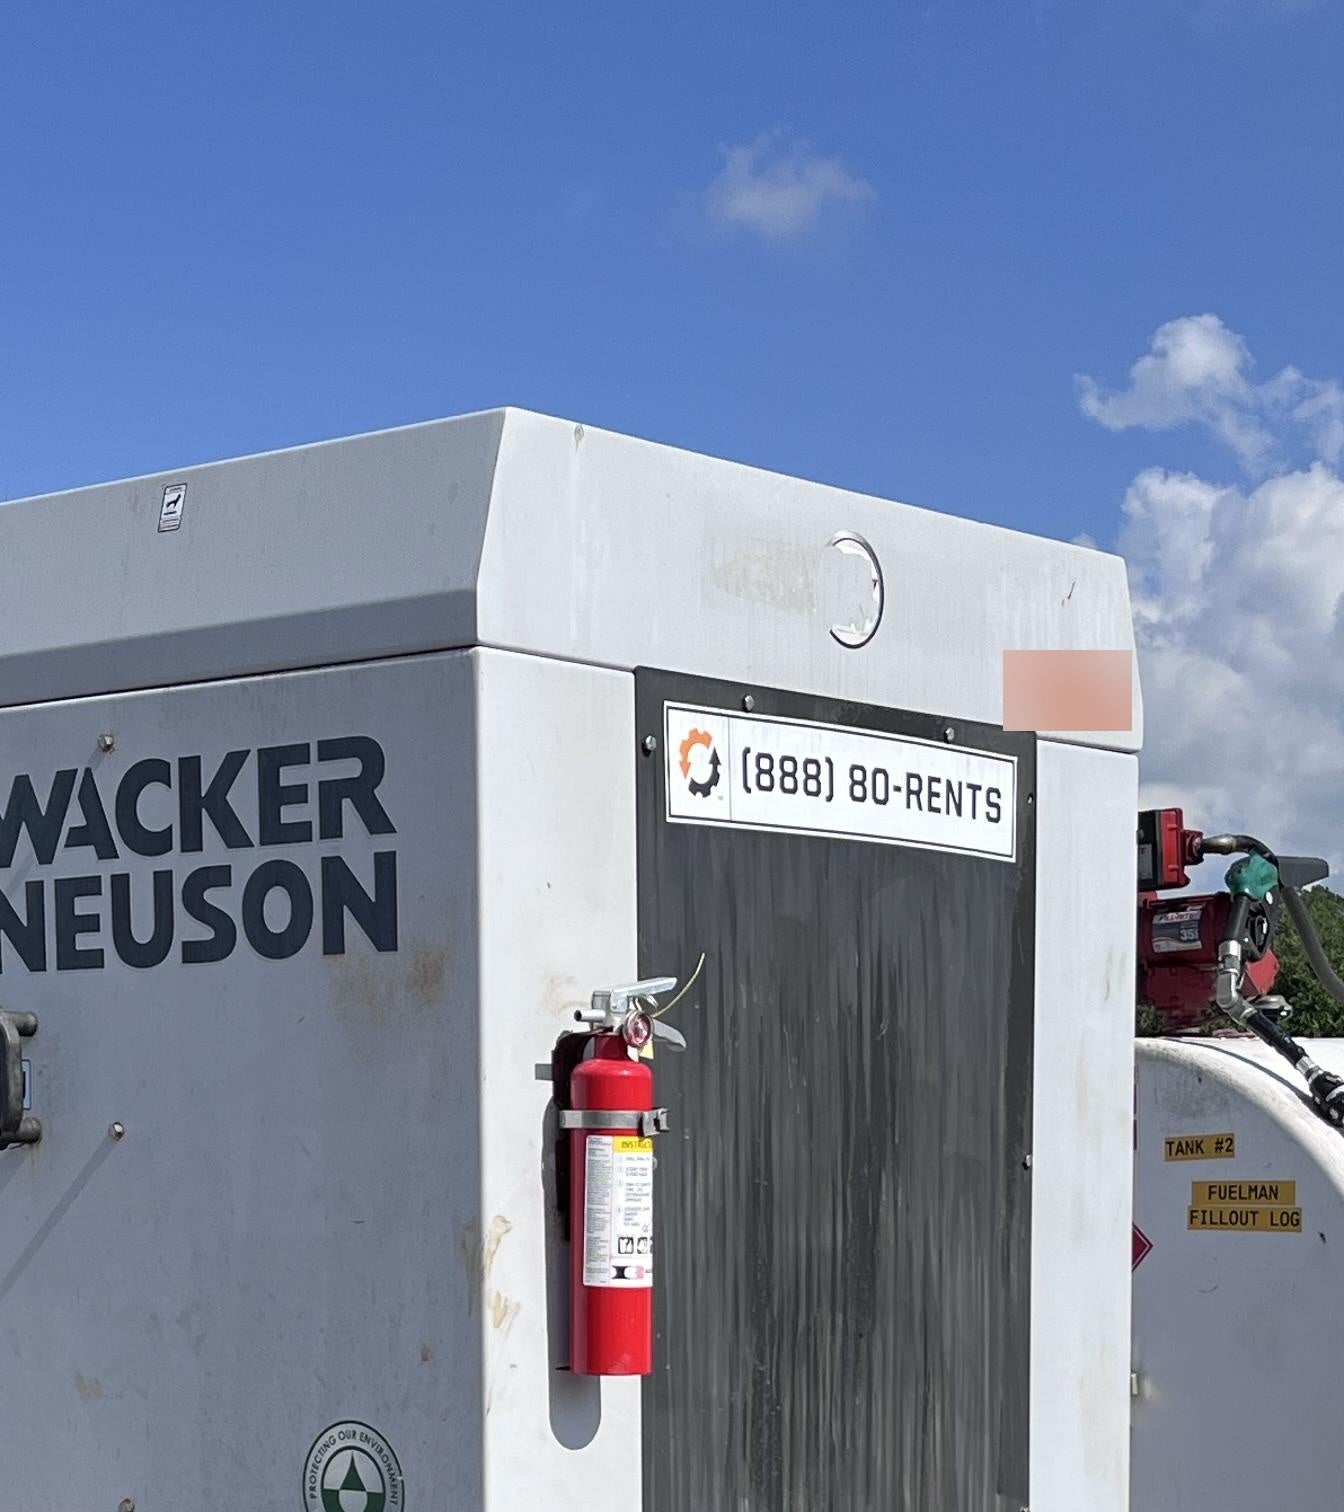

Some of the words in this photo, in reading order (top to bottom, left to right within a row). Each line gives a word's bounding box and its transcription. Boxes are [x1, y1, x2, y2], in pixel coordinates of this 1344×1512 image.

[741, 745, 834, 802] (888)
[847, 763, 1002, 824] 80-RENTS
[1165, 1139, 1205, 1157] TANK
[1214, 1137, 1234, 1154] #2
[1207, 1184, 1279, 1201] FUELMAN
[1189, 1209, 1259, 1226] FILLOUT
[1270, 1211, 1300, 1228] LOG
[309, 1435, 337, 1500] PROTECTING
[337, 1429, 357, 1441] OUR
[359, 1431, 399, 1505] ENVIRONMENT
